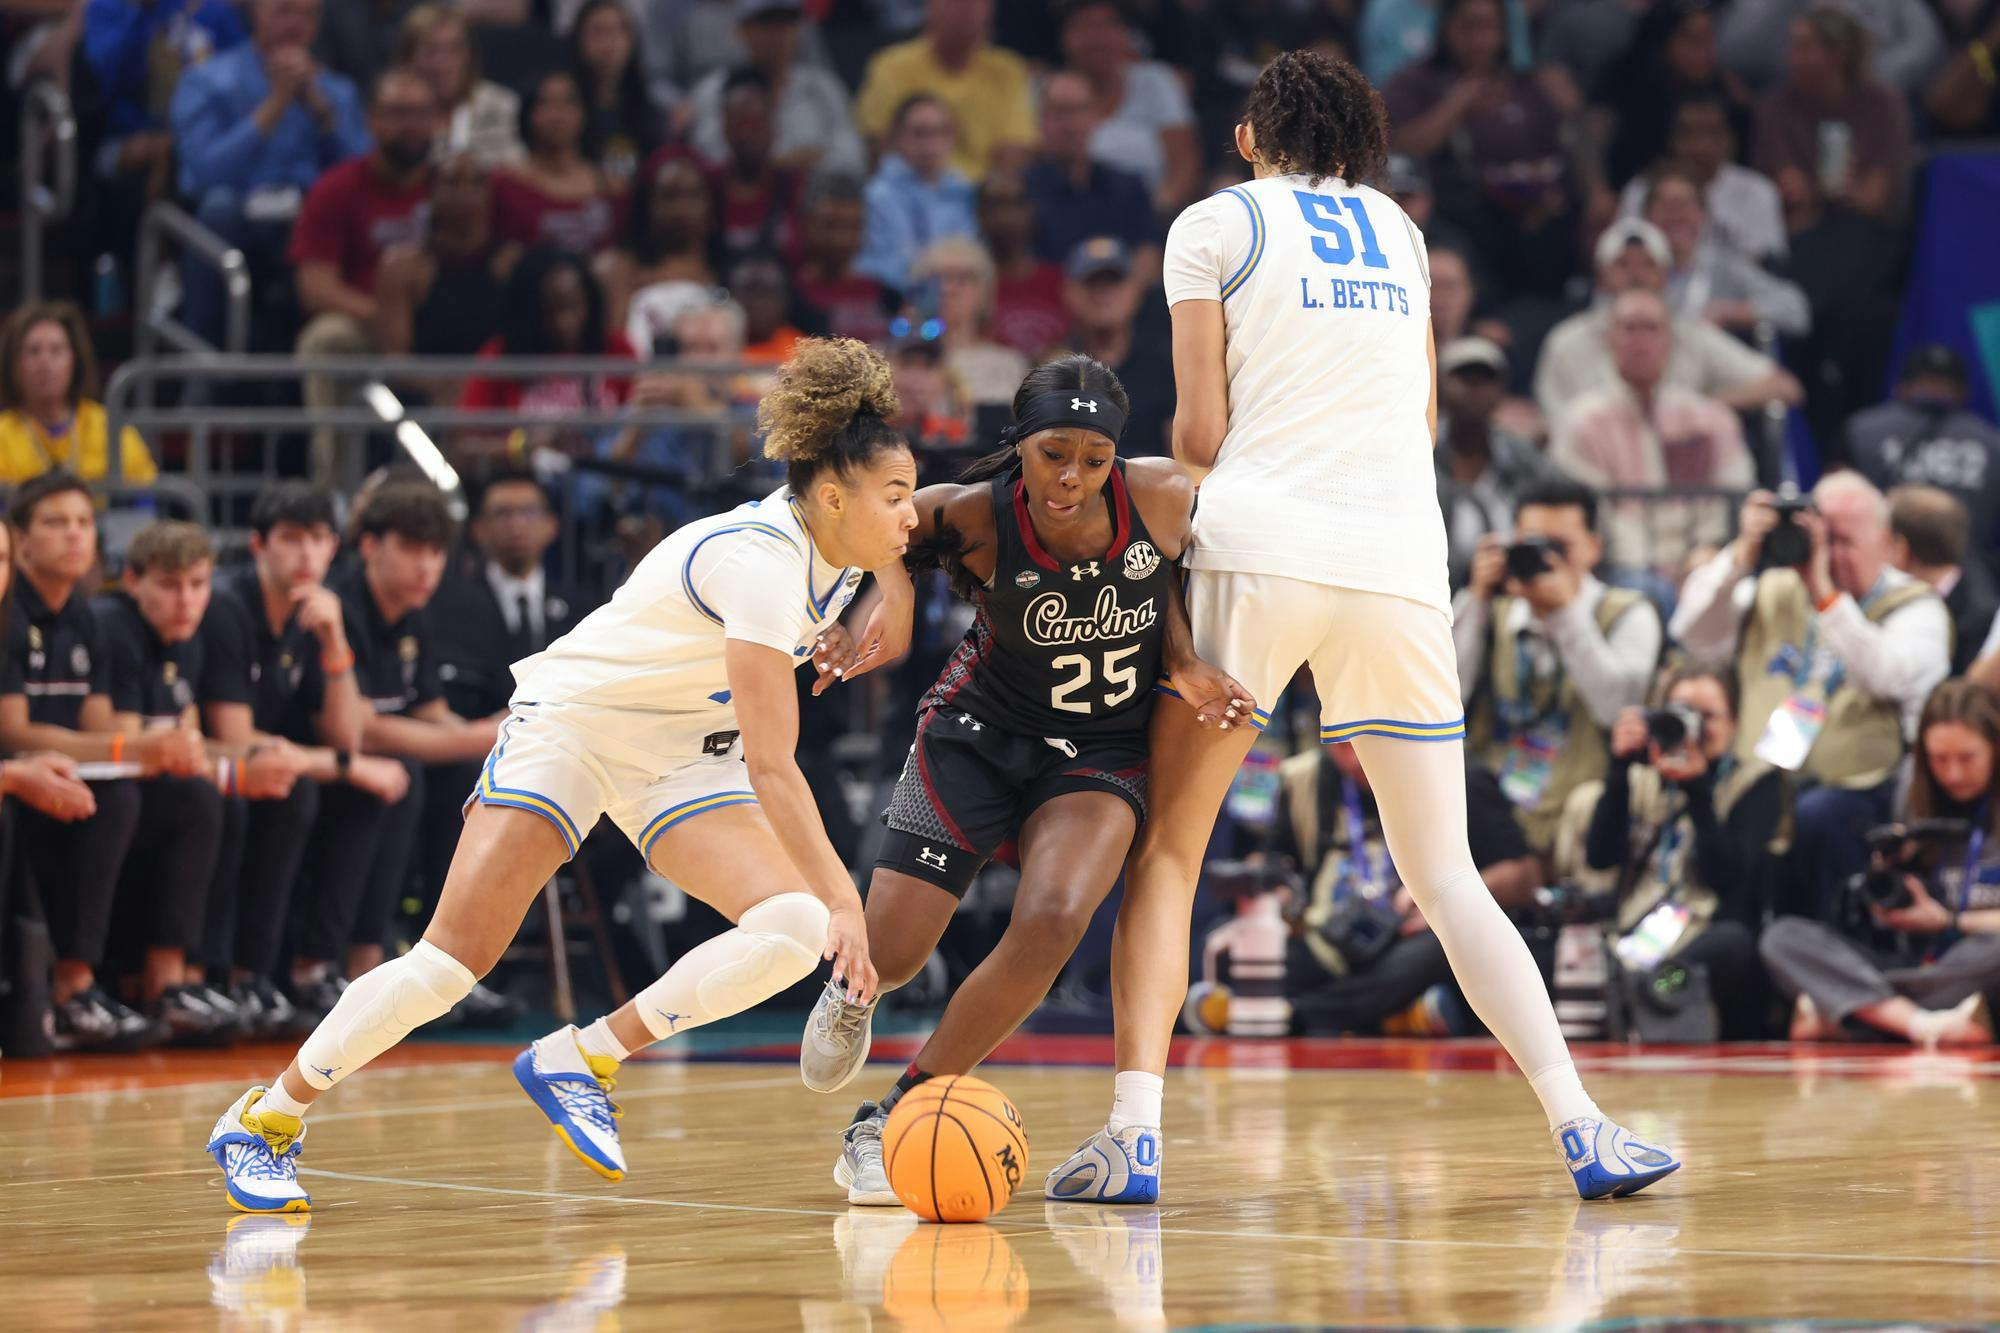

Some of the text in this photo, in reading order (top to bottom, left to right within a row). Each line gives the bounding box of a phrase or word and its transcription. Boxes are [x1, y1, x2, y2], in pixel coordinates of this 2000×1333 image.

[1292, 189, 1390, 270] 51
[1301, 277, 1409, 316] L. BETTS
[1126, 543, 1153, 571] SEC
[1023, 585, 1157, 646] Carolina
[1051, 643, 1141, 714] 25
